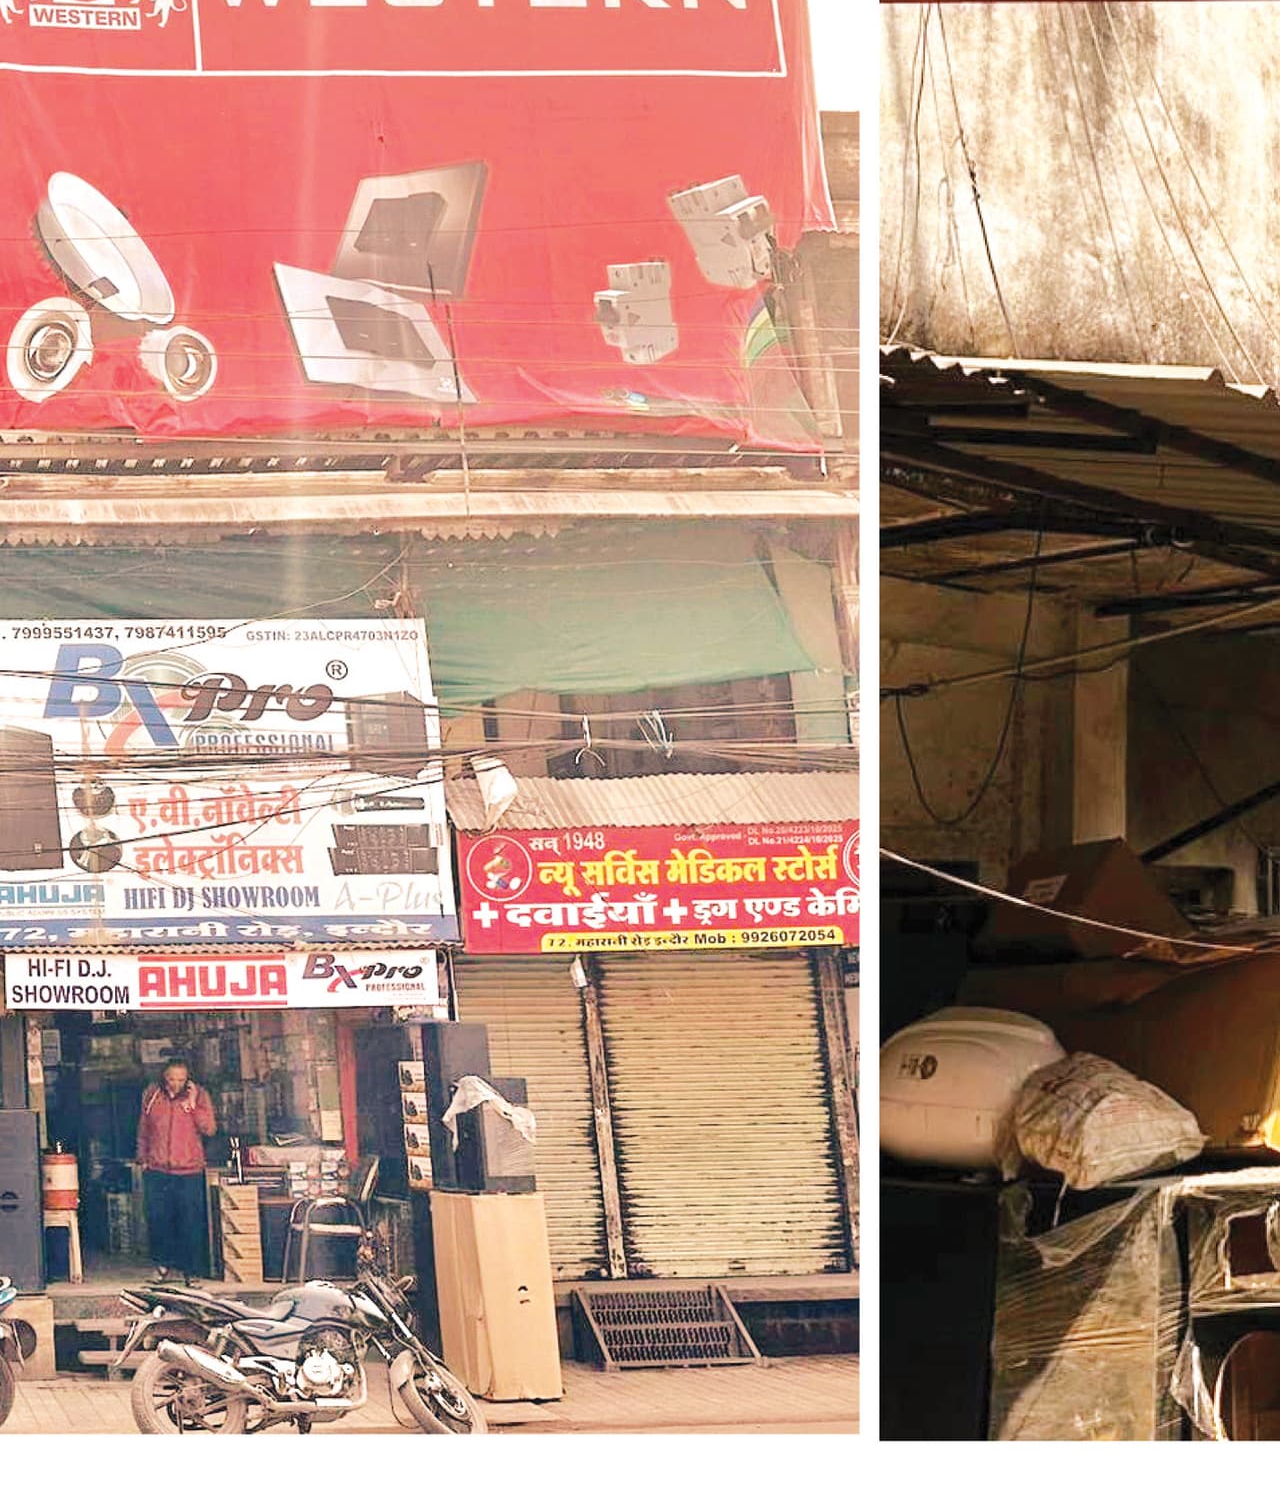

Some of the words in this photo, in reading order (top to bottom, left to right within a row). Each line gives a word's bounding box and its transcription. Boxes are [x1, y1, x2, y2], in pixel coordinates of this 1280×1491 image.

[32, 7, 139, 28] WESTERN
[124, 625, 227, 639] 7987411595
[563, 831, 605, 851] 1948
[537, 861, 582, 897] न्यू
[580, 850, 660, 886] सर्विस
[665, 848, 767, 885] मेडिकल
[771, 844, 840, 881] स्टोर्स
[124, 887, 166, 910] HIFI
[172, 887, 194, 911] DJ
[202, 885, 320, 909] SHOWROOM
[694, 933, 726, 945] Mob
[741, 929, 836, 943] 9926072054
[28, 959, 71, 978] HI-FI
[78, 959, 112, 978] D.J.
[139, 965, 288, 996] AHUJA
[12, 984, 130, 1004] SHOWROOM
